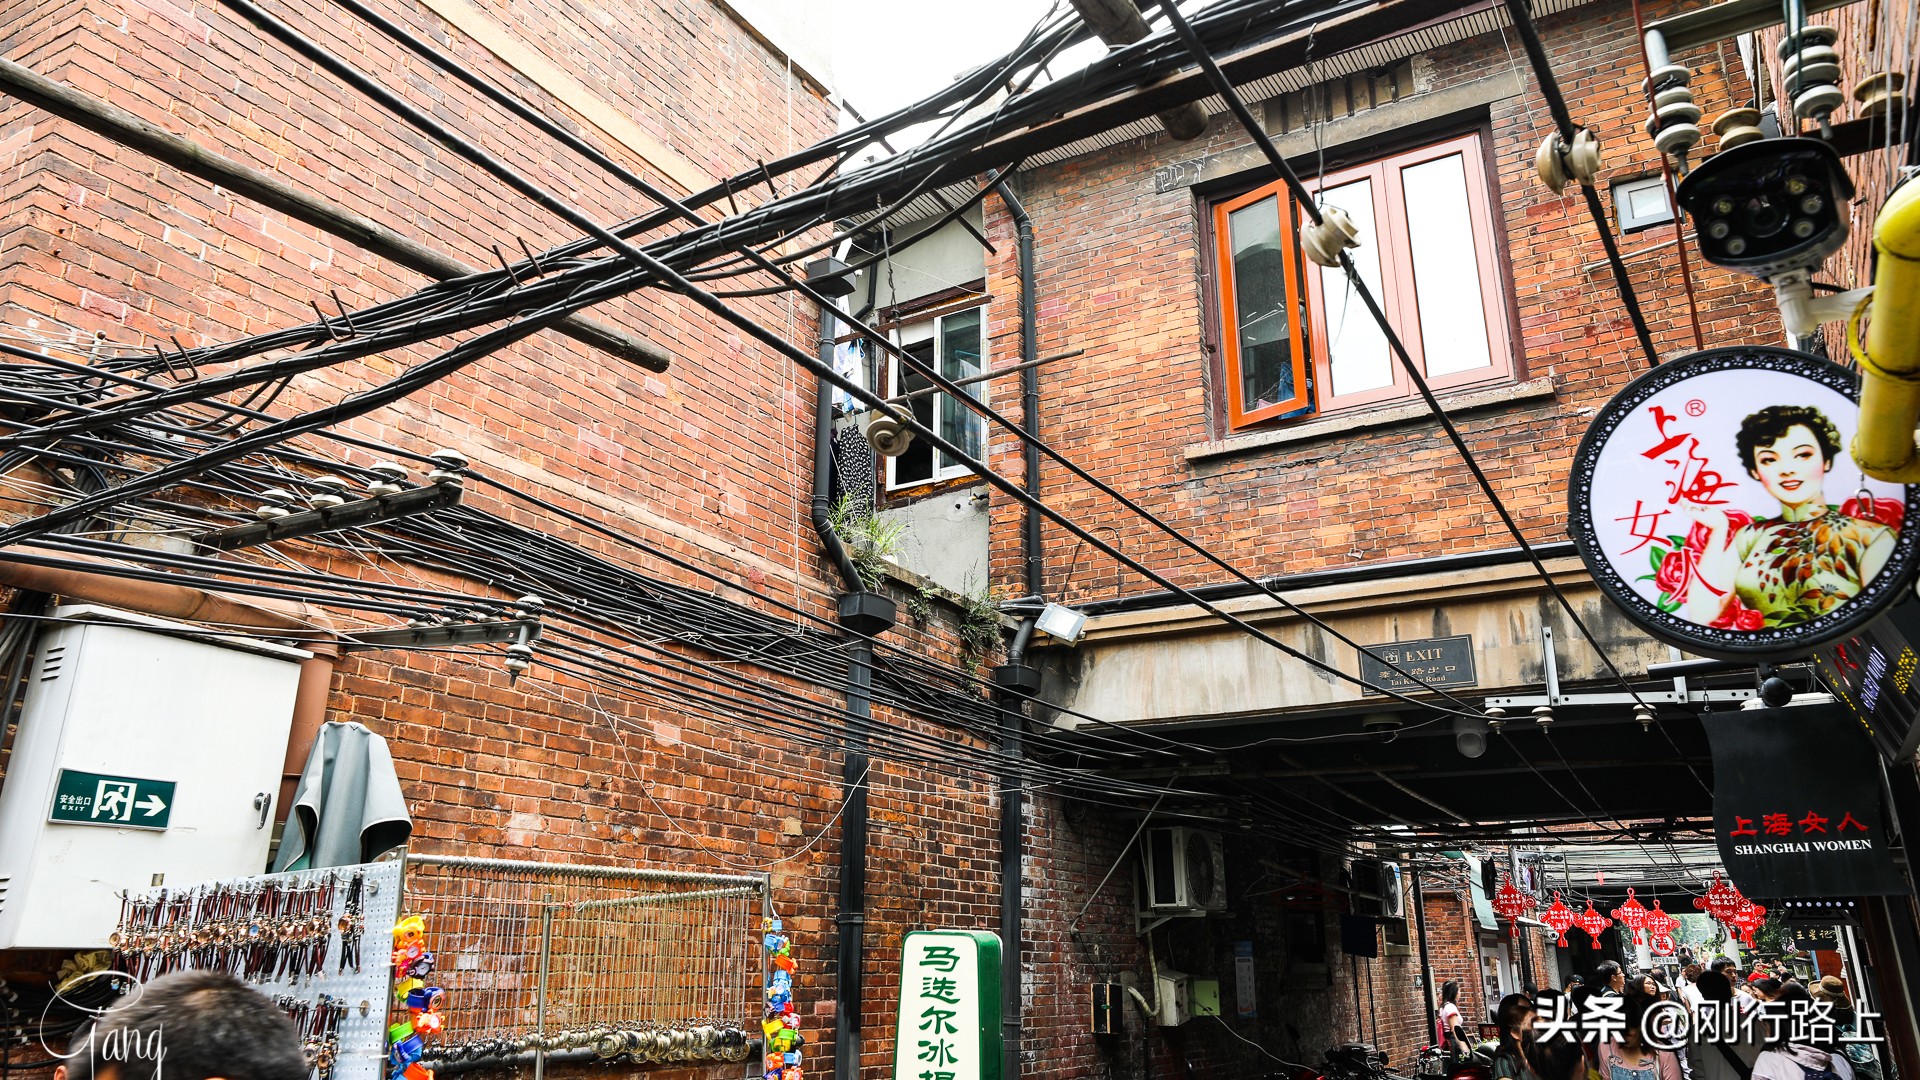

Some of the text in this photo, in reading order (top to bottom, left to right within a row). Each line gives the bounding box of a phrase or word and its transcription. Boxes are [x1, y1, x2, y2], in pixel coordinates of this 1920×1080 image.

[1406, 648, 1442, 662] EXIT
[1426, 675, 1446, 683] Road
[60, 794, 92, 806] 安全出口
[1730, 811, 1868, 837] 上海女人
[1735, 840, 1872, 855] SHANGHAI WOMEN
